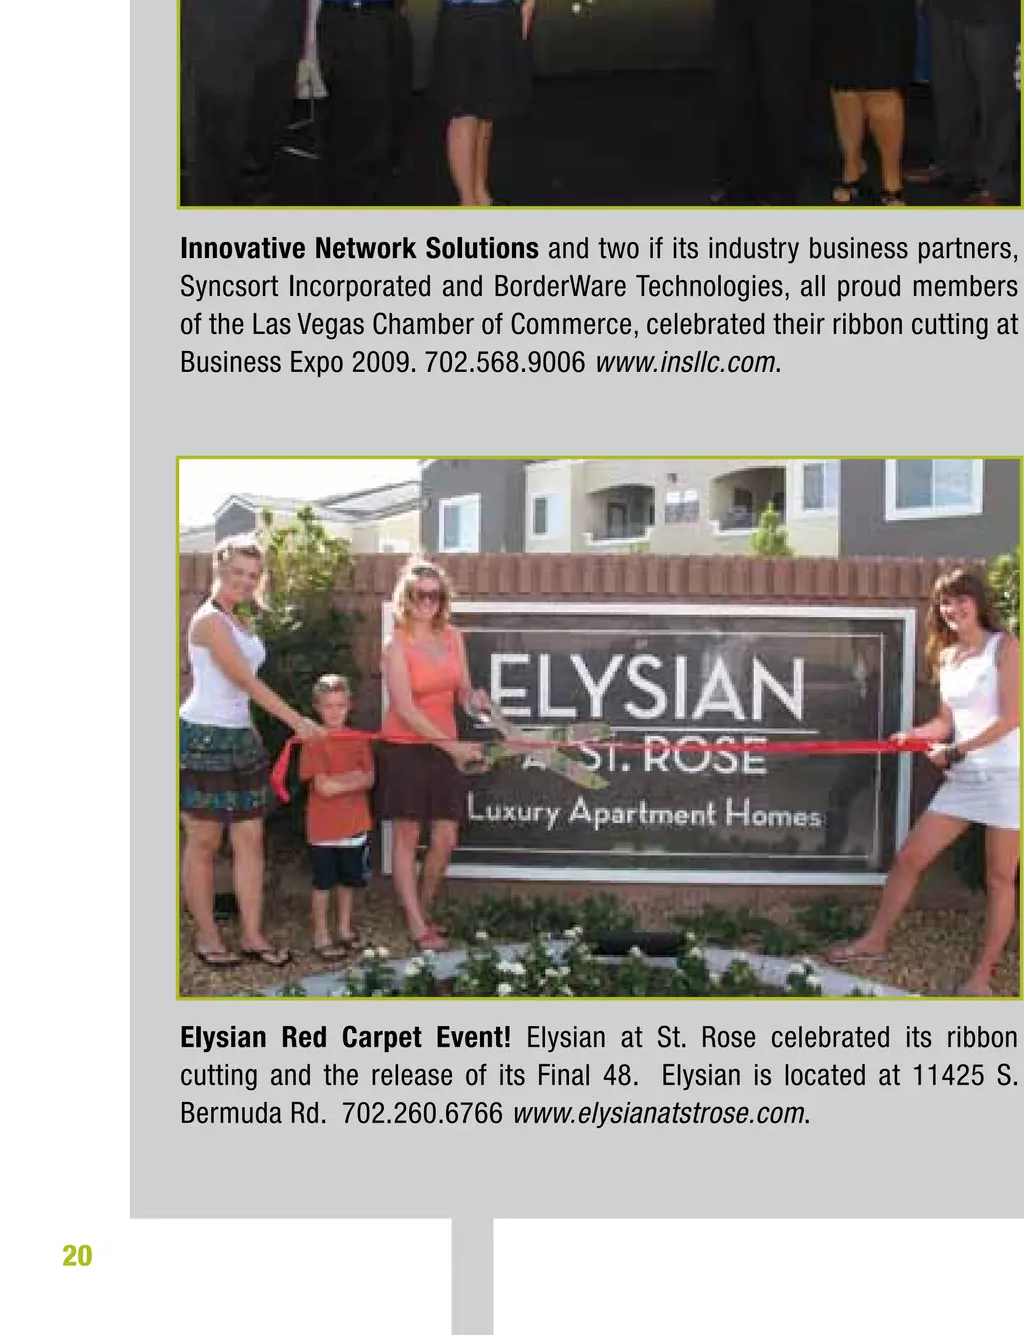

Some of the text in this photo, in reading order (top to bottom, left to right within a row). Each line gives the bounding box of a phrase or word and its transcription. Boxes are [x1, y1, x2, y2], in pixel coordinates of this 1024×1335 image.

[182, 236, 1017, 263] Innovative Network Solutions and two if its industry business partners,
[182, 351, 780, 377] Business Expo 2009. 702.568.9006 www.insllc.com.
[489, 652, 806, 723] ELYSIAN
[643, 734, 769, 775] ROSE
[467, 790, 823, 831] Luxury Apartment Homes
[181, 1025, 1017, 1052] Elysian Red Carpet Event! Elysian at St. Rose celebrated its ribbon
[182, 1102, 809, 1128] Bermuda Rd. 702.260.6766 www.elysianatstrose.com.
[63, 1244, 92, 1266] 20
